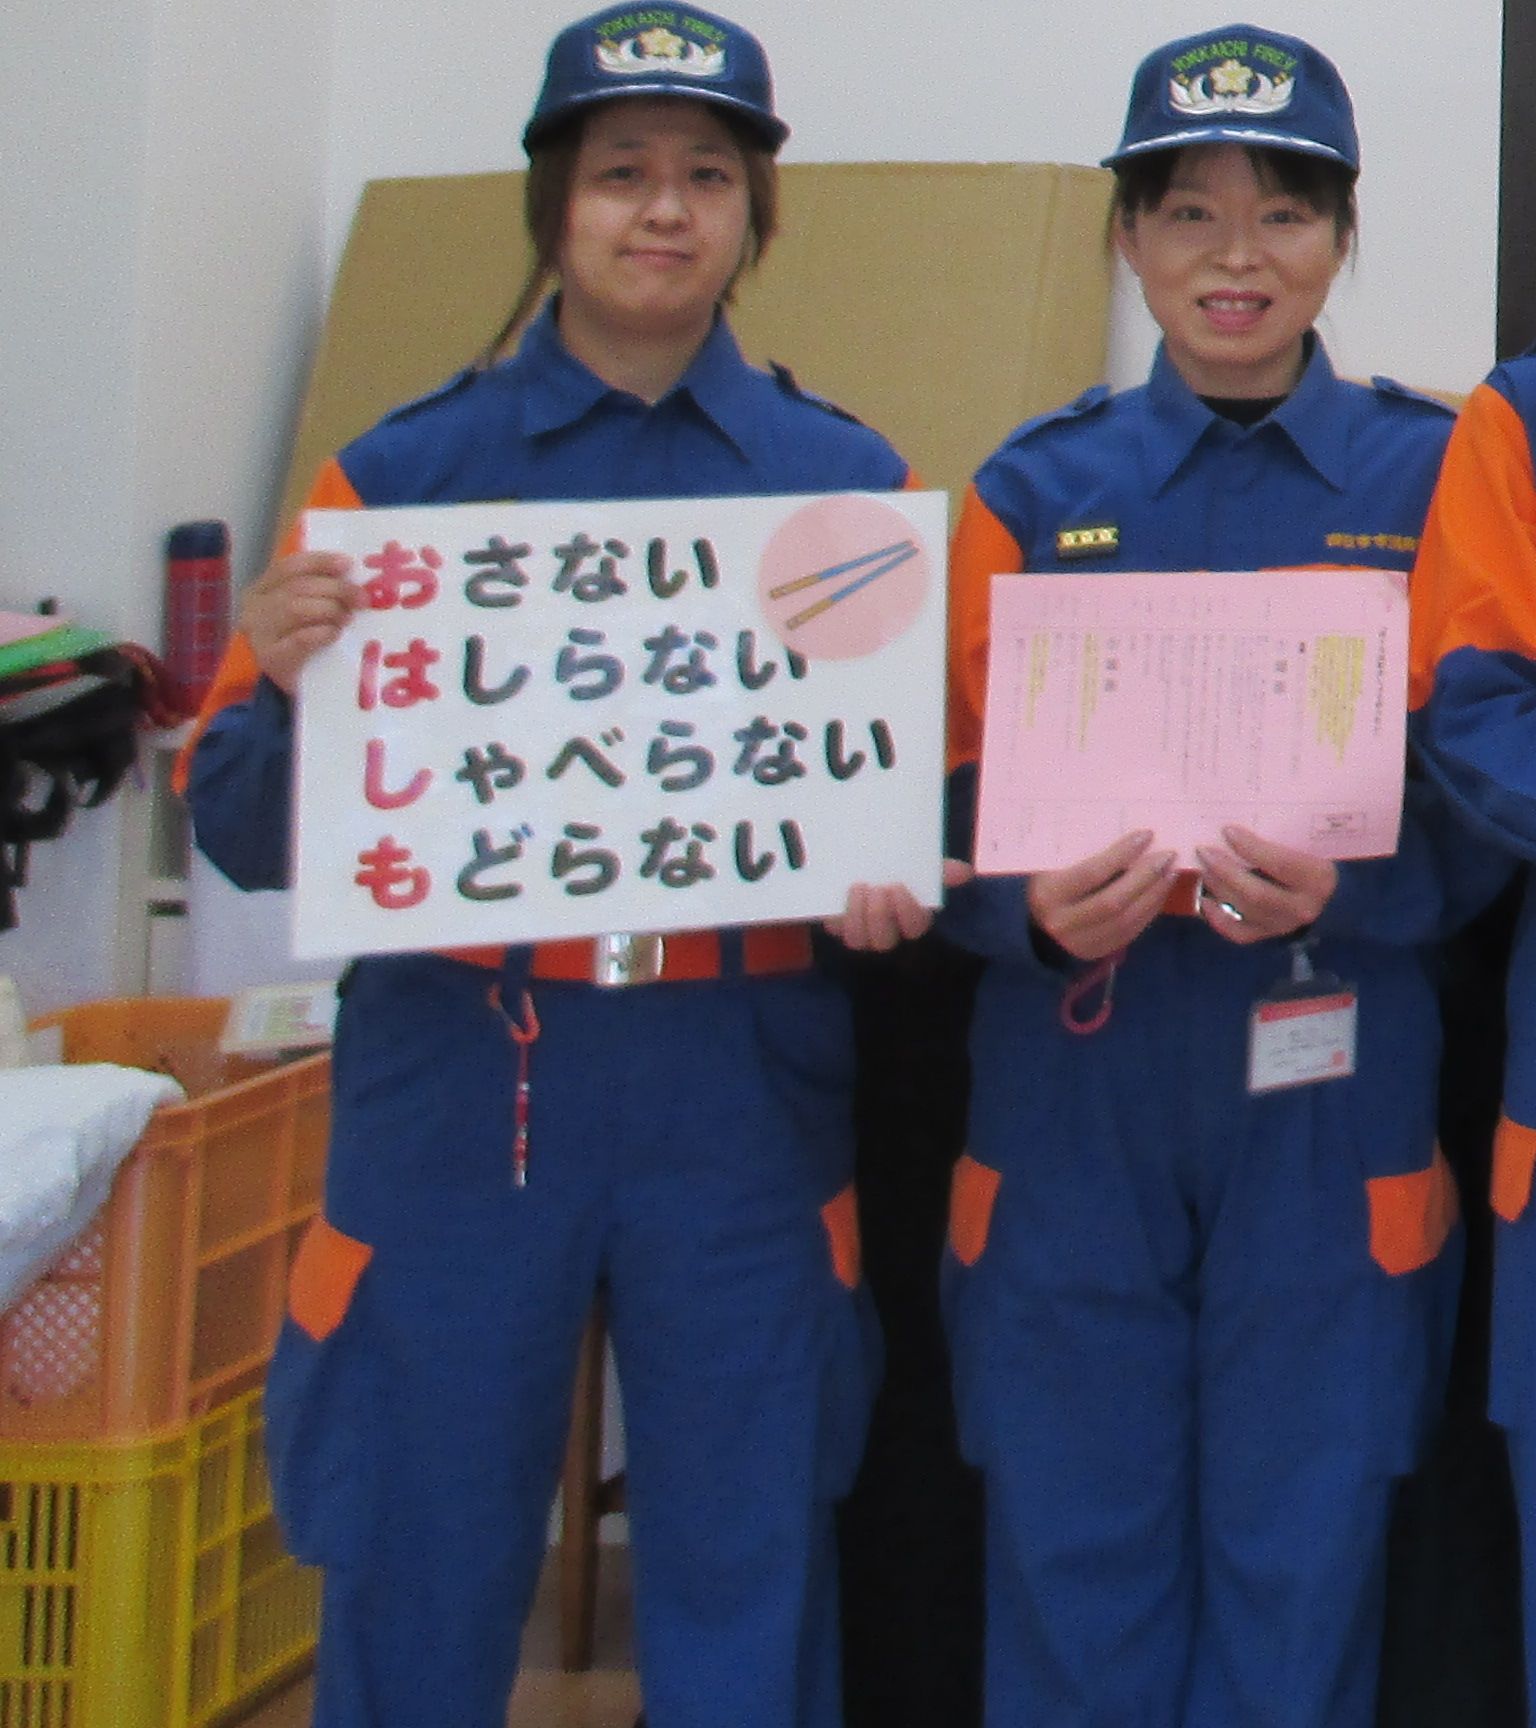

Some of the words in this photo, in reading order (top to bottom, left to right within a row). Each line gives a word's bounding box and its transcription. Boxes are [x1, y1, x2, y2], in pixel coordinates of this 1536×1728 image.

[361, 532, 721, 611] おさない
[357, 625, 809, 710] はしらない
[363, 715, 896, 810] しゃべらない
[354, 817, 807, 909] もどらない
